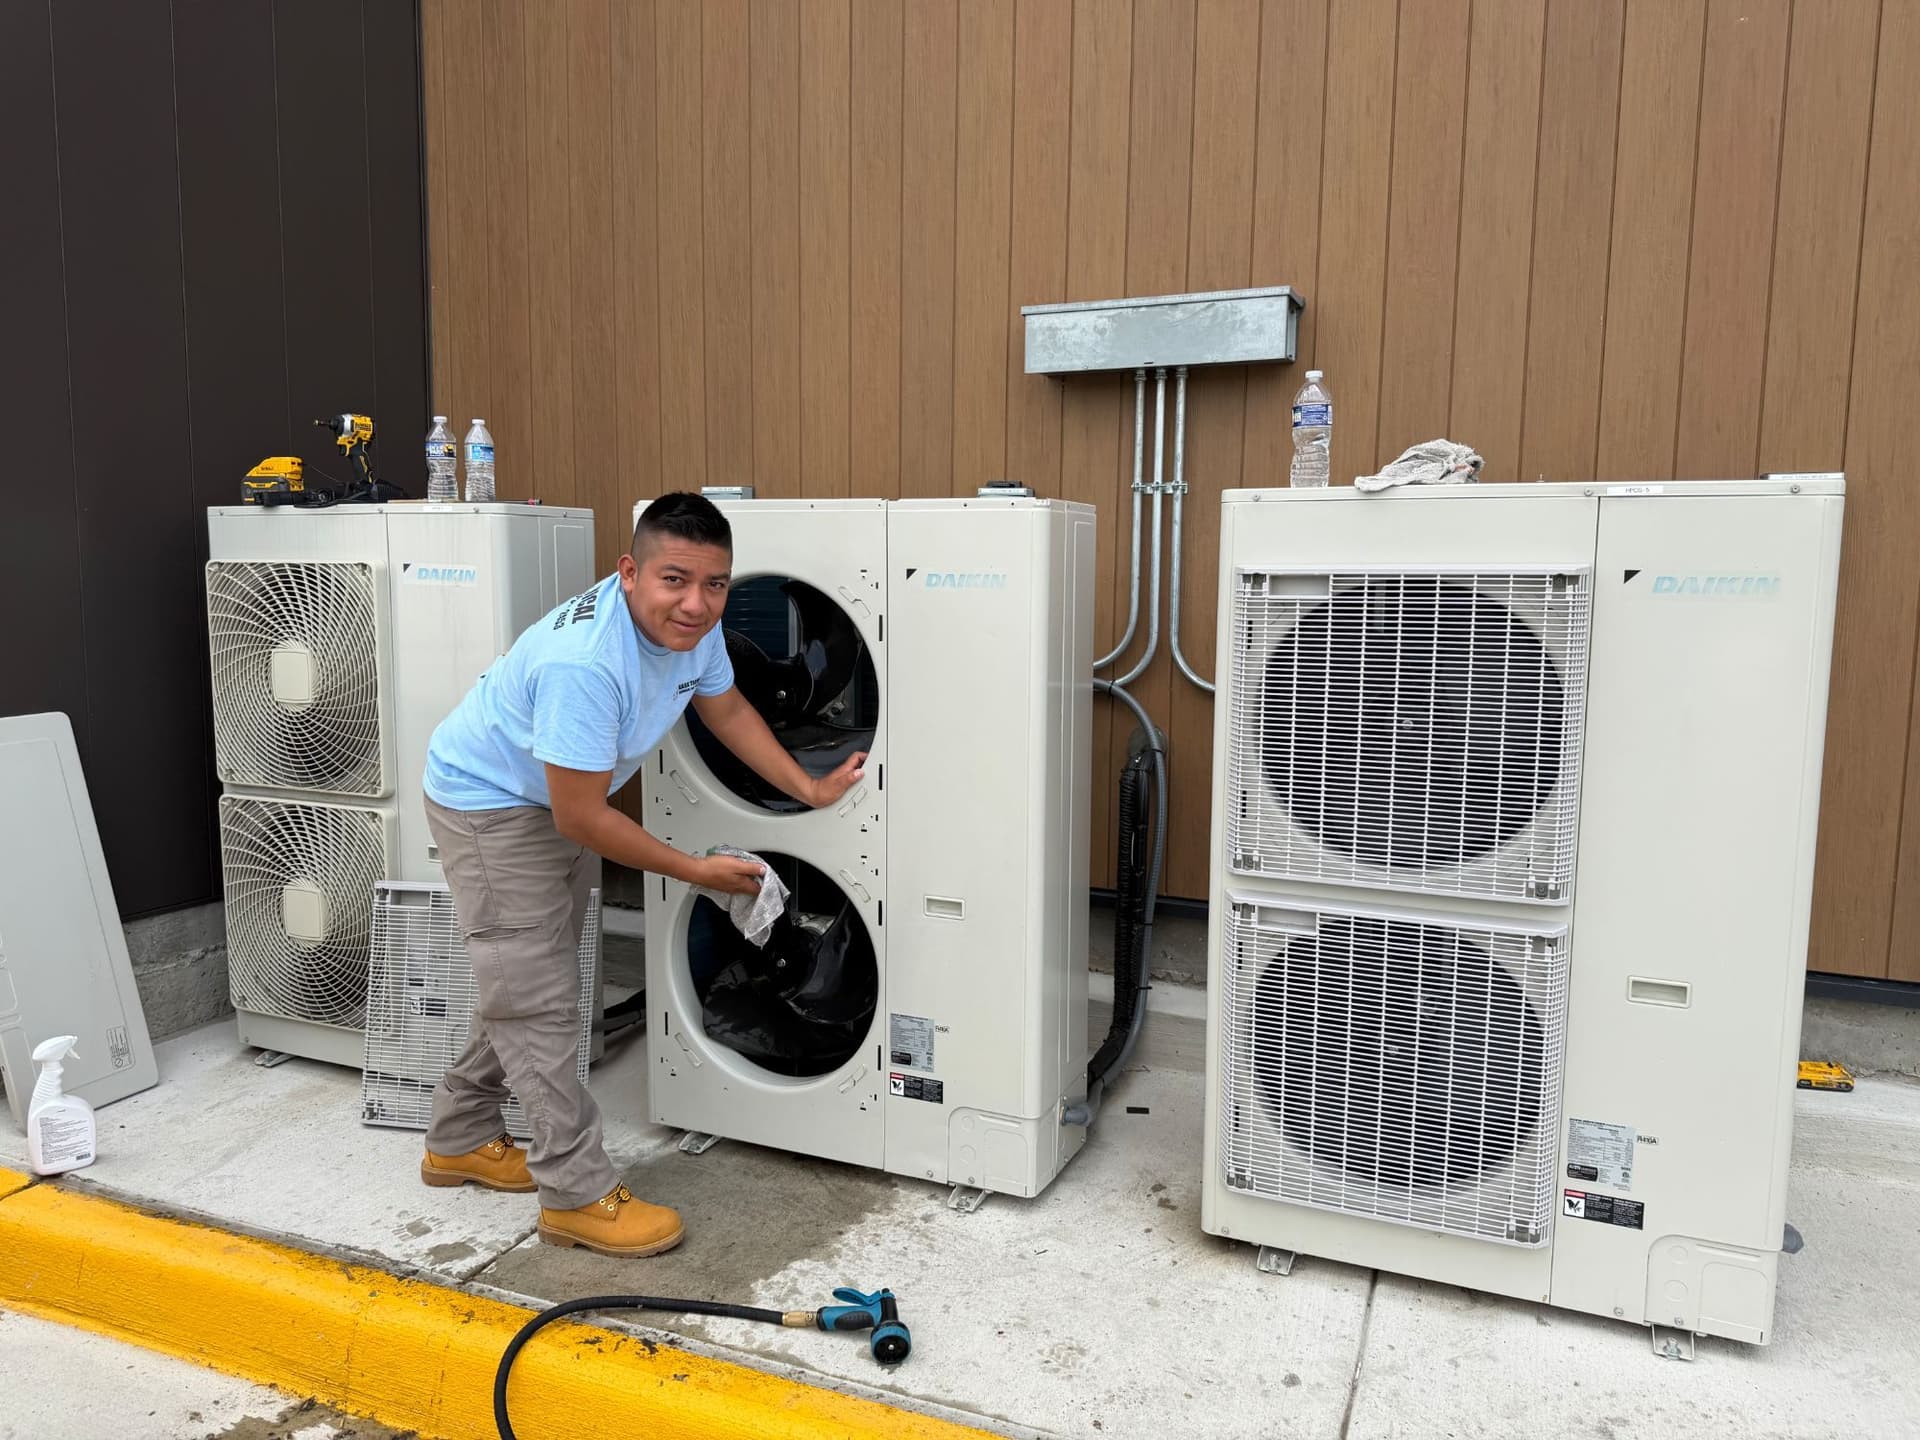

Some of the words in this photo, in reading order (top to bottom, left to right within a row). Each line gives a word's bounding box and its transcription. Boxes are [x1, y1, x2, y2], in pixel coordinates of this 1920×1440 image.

[417, 567, 476, 582] DAIKIN
[926, 573, 1007, 588] DAIKIN
[1652, 575, 1781, 594] DAIKIN
